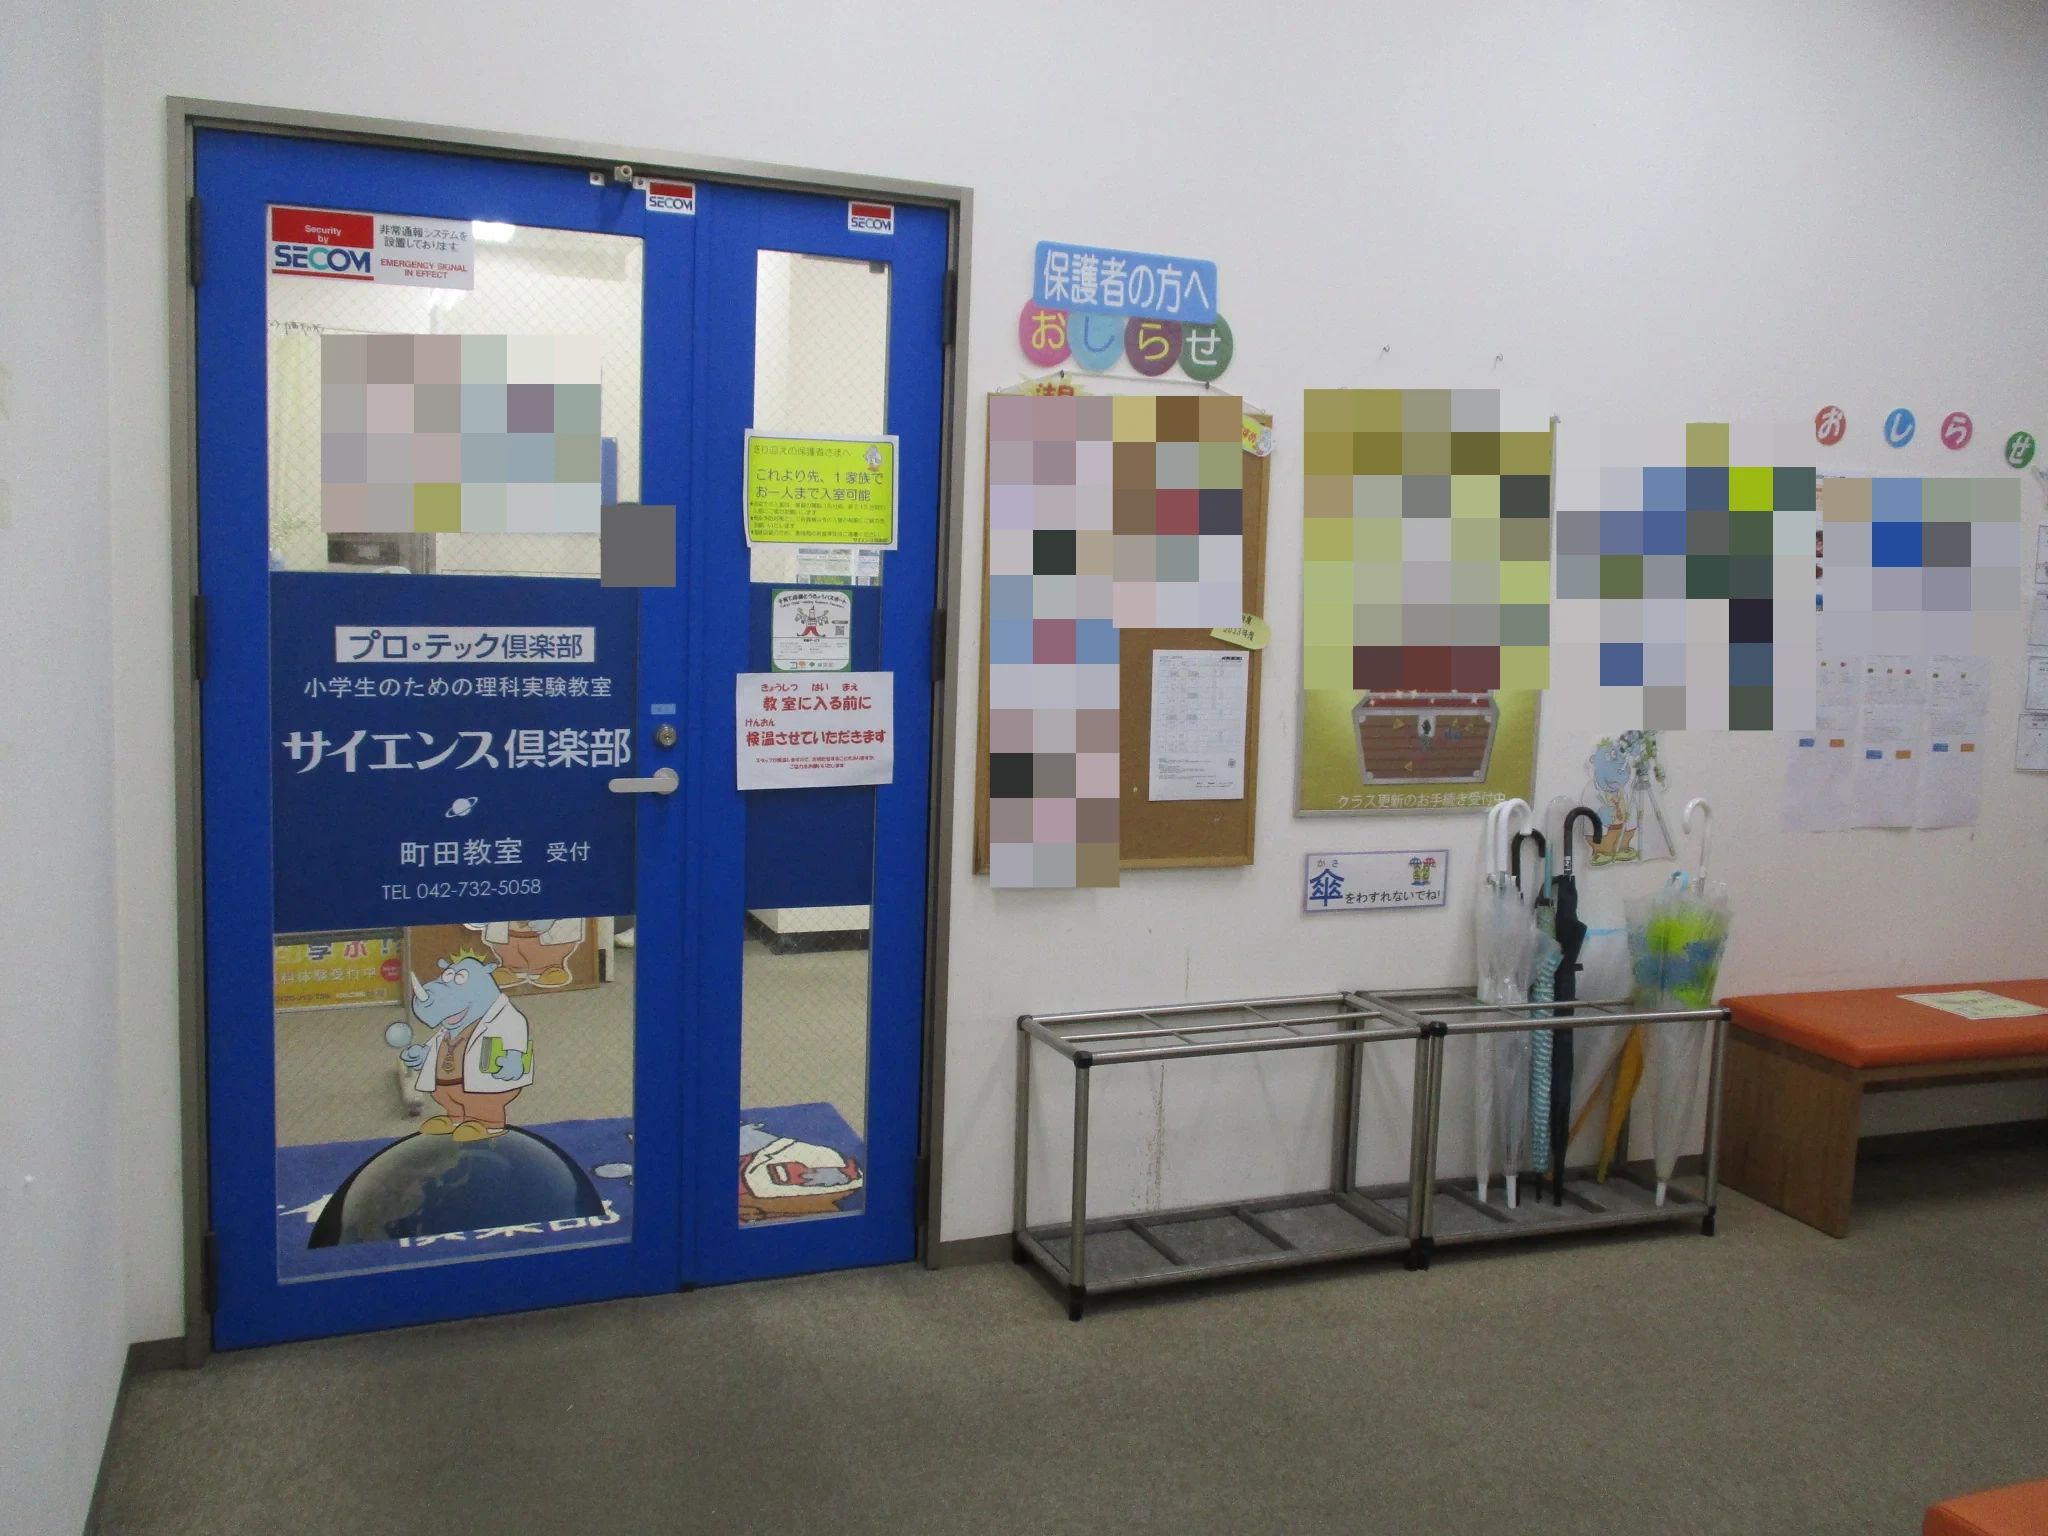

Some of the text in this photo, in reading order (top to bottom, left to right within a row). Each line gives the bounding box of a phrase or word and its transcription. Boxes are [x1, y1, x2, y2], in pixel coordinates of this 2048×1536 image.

[649, 196, 693, 211] SECOM
[304, 224, 342, 237] Security
[851, 217, 892, 231] SECOM
[318, 235, 329, 244] by
[380, 224, 468, 241] 非常通報システムを
[384, 237, 458, 251] 設置しております
[275, 245, 370, 273] SECOM
[380, 258, 468, 272] EMERGENCY SIGNAL
[404, 269, 447, 279] IN EFFECT
[1044, 249, 1209, 313] 保護者の方へ
[1031, 310, 1221, 366] おしらせ
[1817, 407, 2031, 465] おしらせ
[756, 486, 871, 502] お一人まで入室可能
[349, 629, 584, 660] プロ・テック倶楽部
[304, 676, 611, 699] 小学生のための理科実験教室
[761, 683, 858, 692] きょうしつ はい まえ
[763, 696, 872, 711] 教室に入る前に
[745, 718, 775, 727] けんおん
[746, 729, 886, 747] 検温させていただきます
[281, 728, 631, 774] サイエンス倶楽部
[400, 837, 591, 867] 町田教室 受付
[1317, 859, 1339, 868] かさ
[382, 879, 541, 900] TEL 042-732-5058
